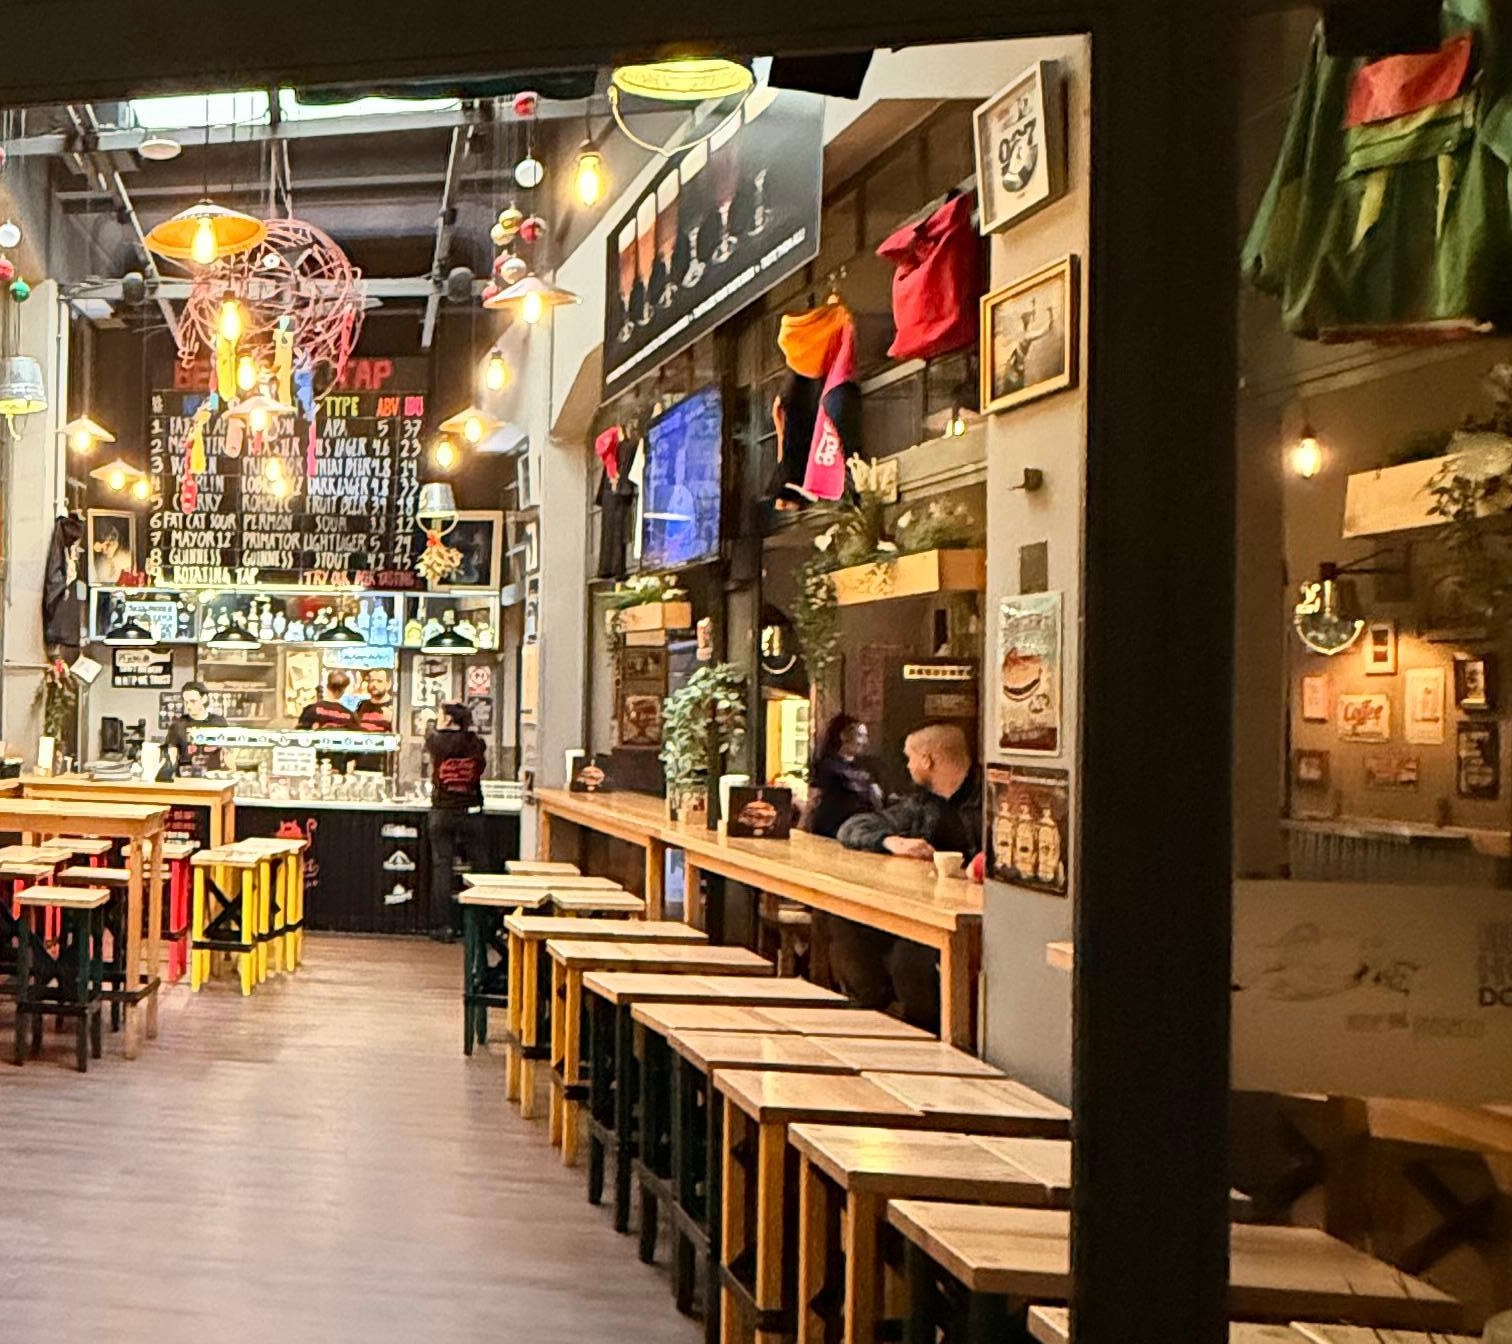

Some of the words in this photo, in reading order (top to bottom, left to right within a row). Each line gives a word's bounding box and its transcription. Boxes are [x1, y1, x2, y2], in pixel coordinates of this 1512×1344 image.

[326, 396, 361, 417] TYPE
[375, 396, 401, 417] ABV
[151, 419, 164, 435] 1
[323, 419, 348, 438] APA
[377, 419, 389, 438] 5
[150, 438, 164, 455] 2
[400, 438, 422, 457] 23
[150, 456, 164, 474] 3
[175, 475, 225, 493] MRLIN
[149, 512, 162, 529] 6
[163, 511, 184, 529] FAT
[185, 513, 206, 530] CAT
[396, 517, 414, 534] 12
[149, 531, 162, 547] 7
[170, 530, 216, 548] MAYOR
[303, 532, 338, 552] LIGHT
[370, 534, 381, 553] 5
[149, 547, 163, 566] 8
[168, 548, 222, 567] GUINNESS
[242, 549, 294, 569] GUINNESS
[313, 551, 352, 570] STOUT
[173, 565, 231, 586] ROTATING
